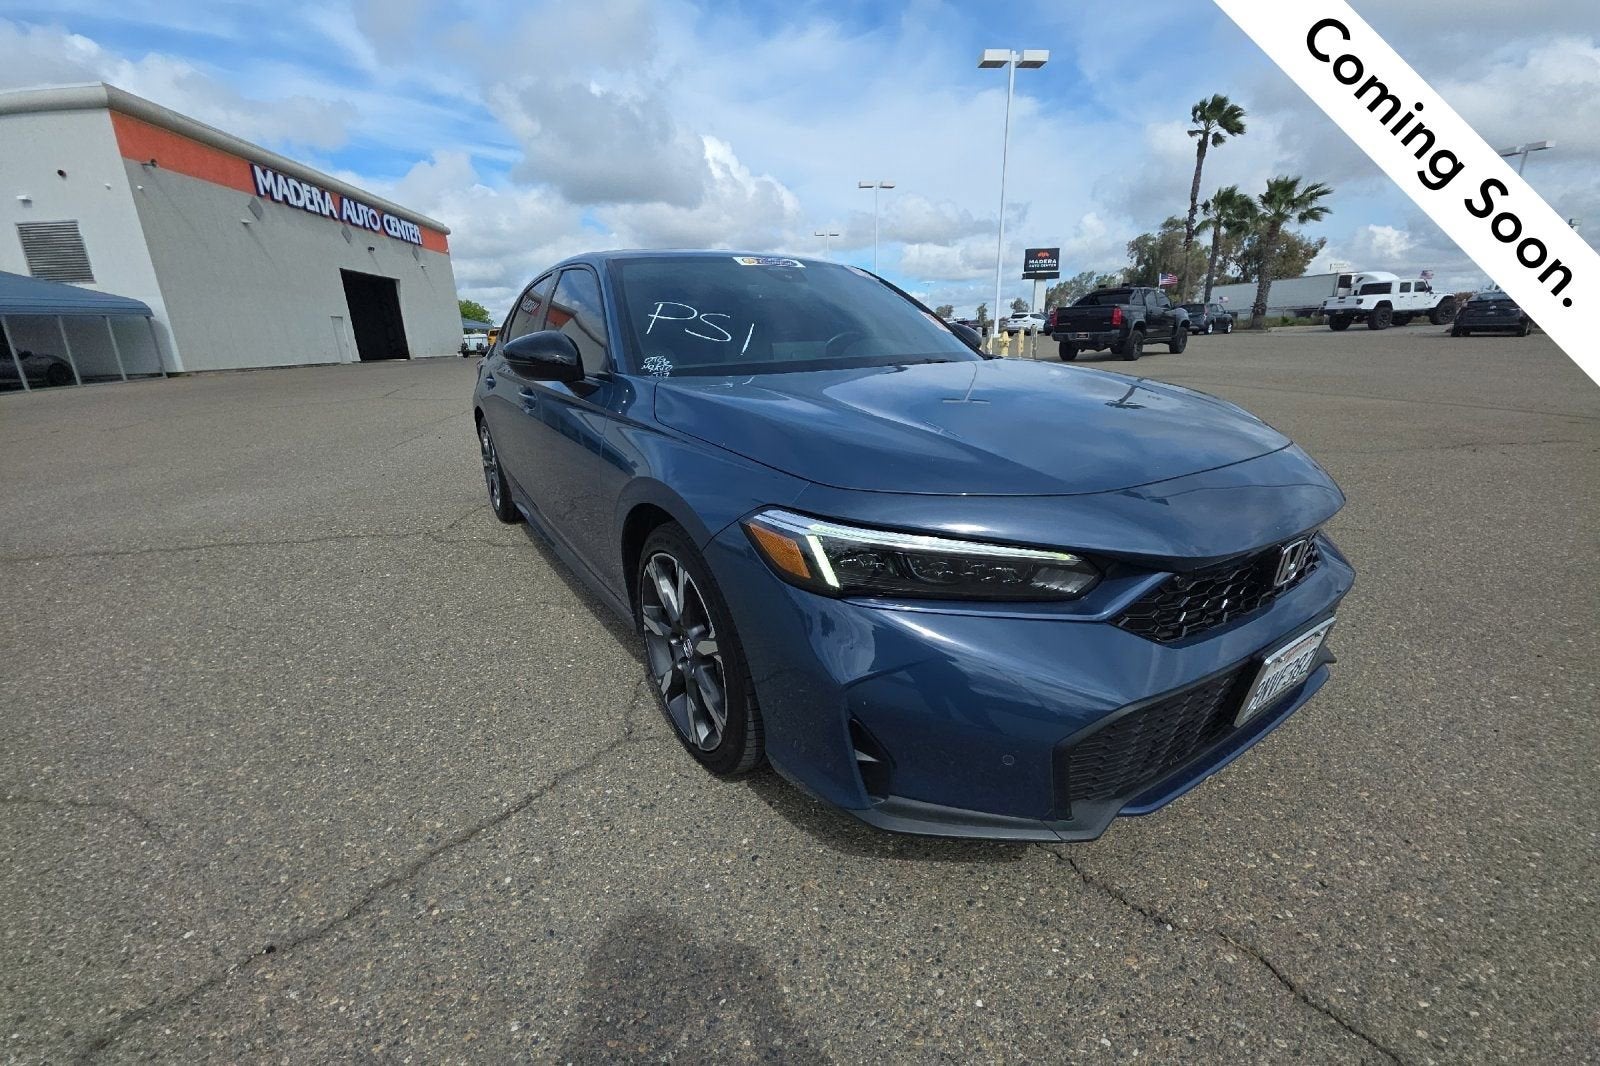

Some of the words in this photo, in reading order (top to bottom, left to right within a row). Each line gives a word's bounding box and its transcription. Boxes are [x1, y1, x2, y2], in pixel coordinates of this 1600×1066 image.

[252, 164, 339, 219] MADERA
[341, 197, 380, 232] AUTO
[382, 213, 423, 245] CENTER
